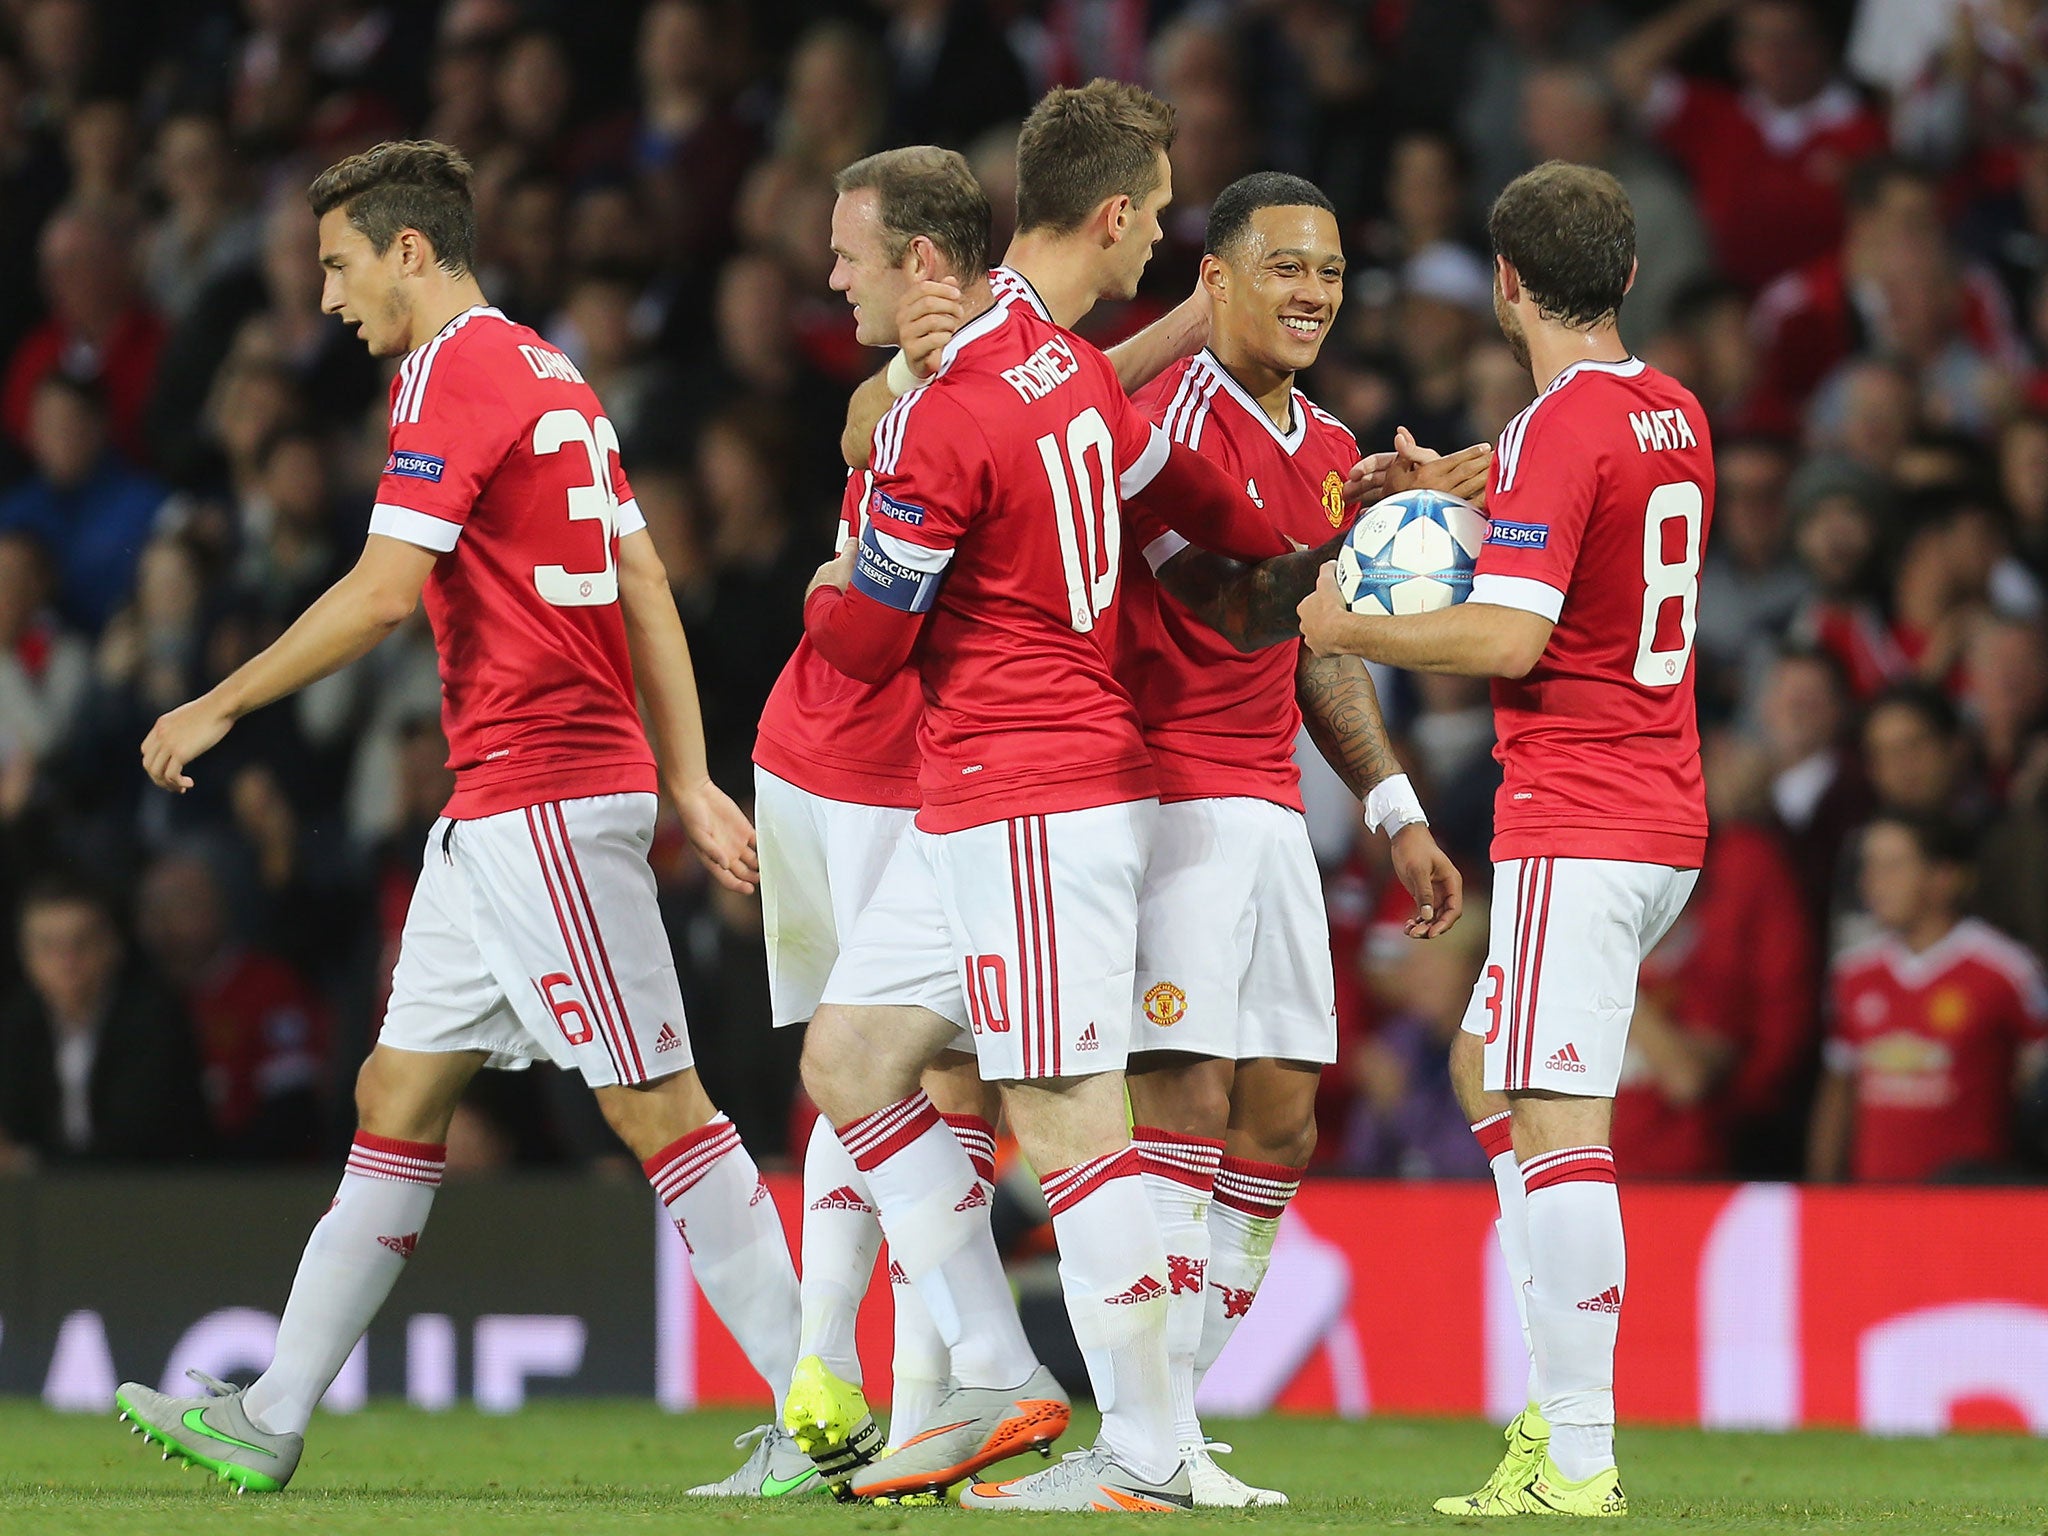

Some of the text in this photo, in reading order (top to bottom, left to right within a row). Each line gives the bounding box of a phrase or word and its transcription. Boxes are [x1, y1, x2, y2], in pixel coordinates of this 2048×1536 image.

[1629, 408, 1698, 453] MATA
[397, 457, 443, 476] RESPECT
[1036, 406, 1121, 633] 10
[1492, 526, 1548, 543] RESPECT
[873, 553, 922, 583] RACISM
[1632, 481, 1703, 686] 8
[964, 953, 1011, 1035] 10
[655, 1037, 682, 1054] adidas
[1075, 1039, 1100, 1052] adidas
[1545, 1060, 1587, 1073] adidas
[810, 1199, 873, 1214] adidas
[1104, 1285, 1168, 1305] adidas
